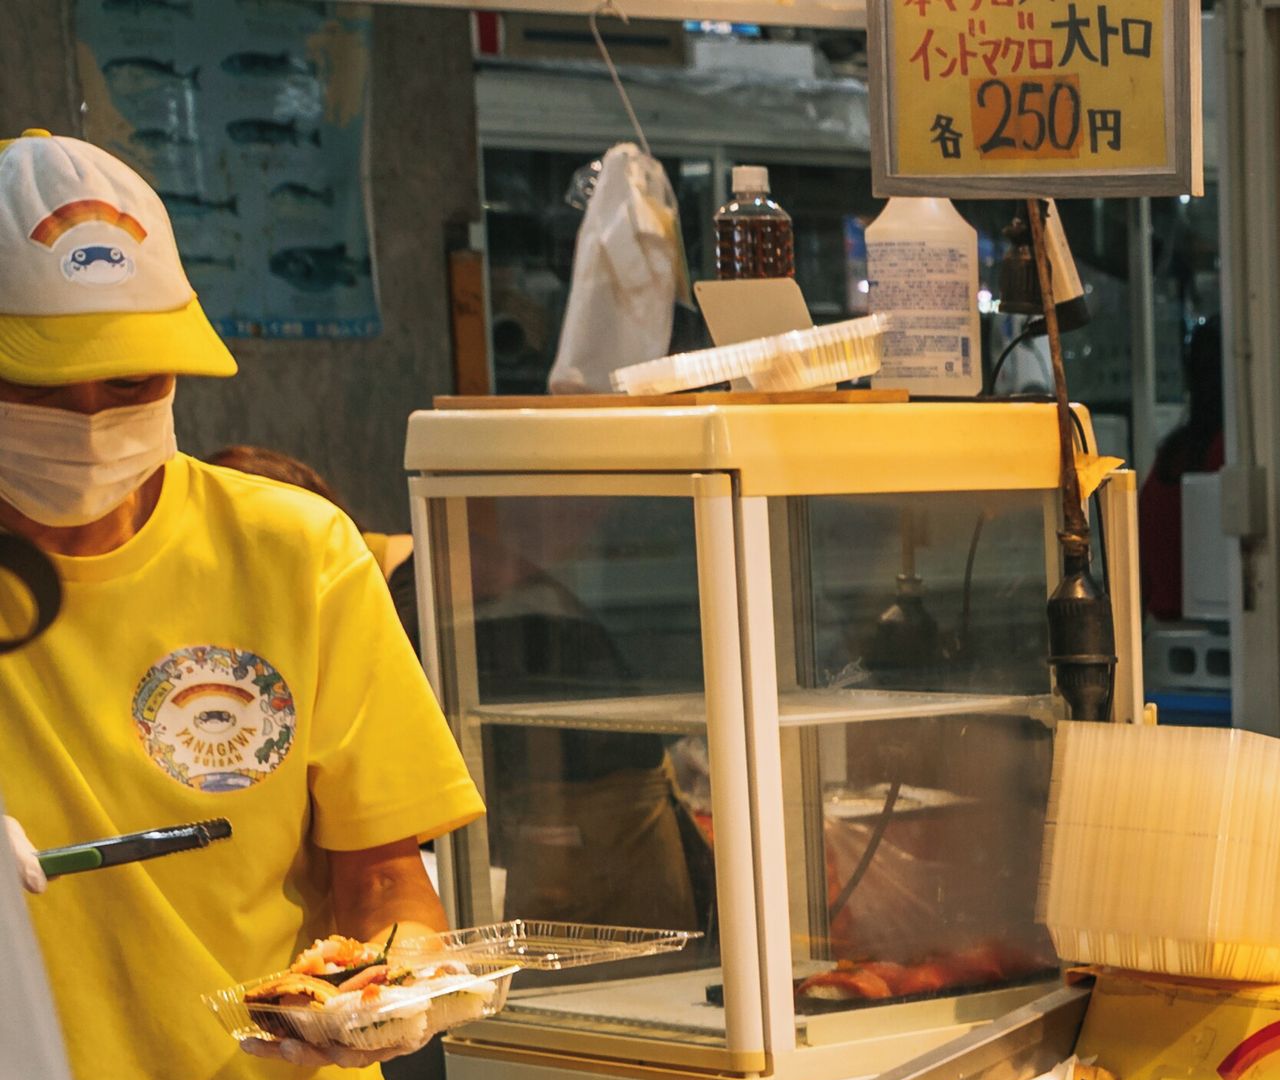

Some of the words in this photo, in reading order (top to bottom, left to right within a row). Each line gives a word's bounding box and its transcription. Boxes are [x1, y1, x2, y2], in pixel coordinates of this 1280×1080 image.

[910, 11, 1054, 81] インドマグロ
[1050, 3, 1153, 67] 大トロ
[175, 726, 258, 757] YANAGAWA
